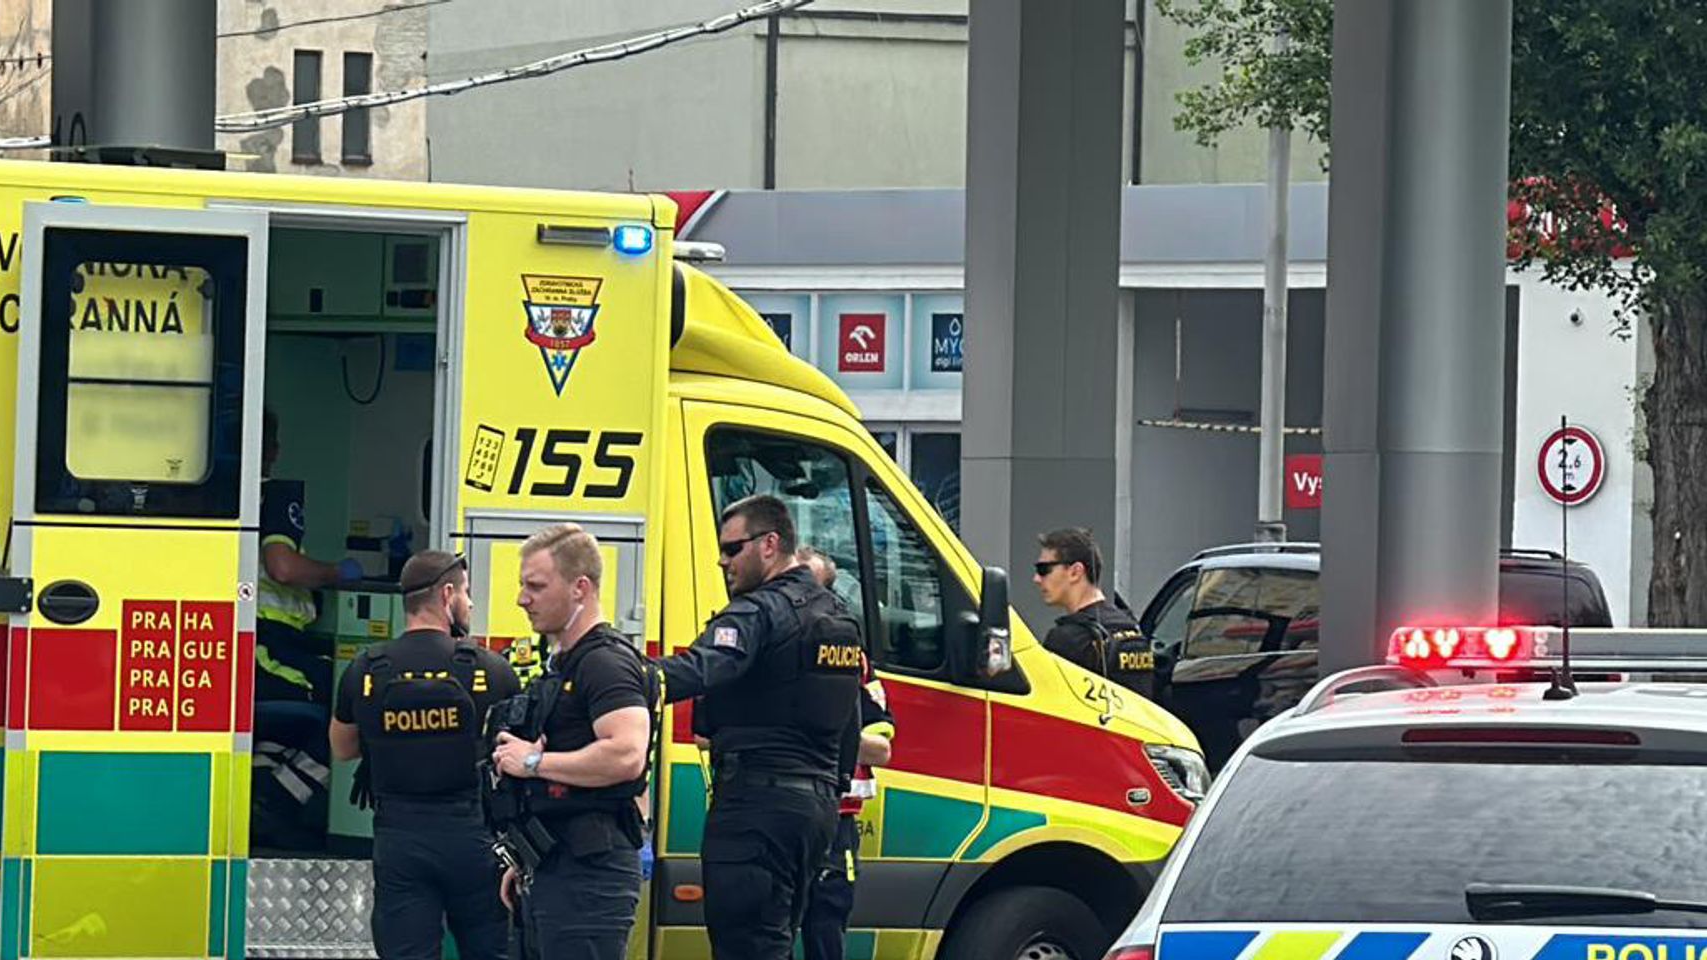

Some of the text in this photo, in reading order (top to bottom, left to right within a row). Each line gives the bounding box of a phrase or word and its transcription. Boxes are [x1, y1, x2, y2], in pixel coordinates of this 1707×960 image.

[845, 352, 879, 363] ORLEN
[507, 427, 644, 498] 155
[383, 707, 459, 732] POLICIE
